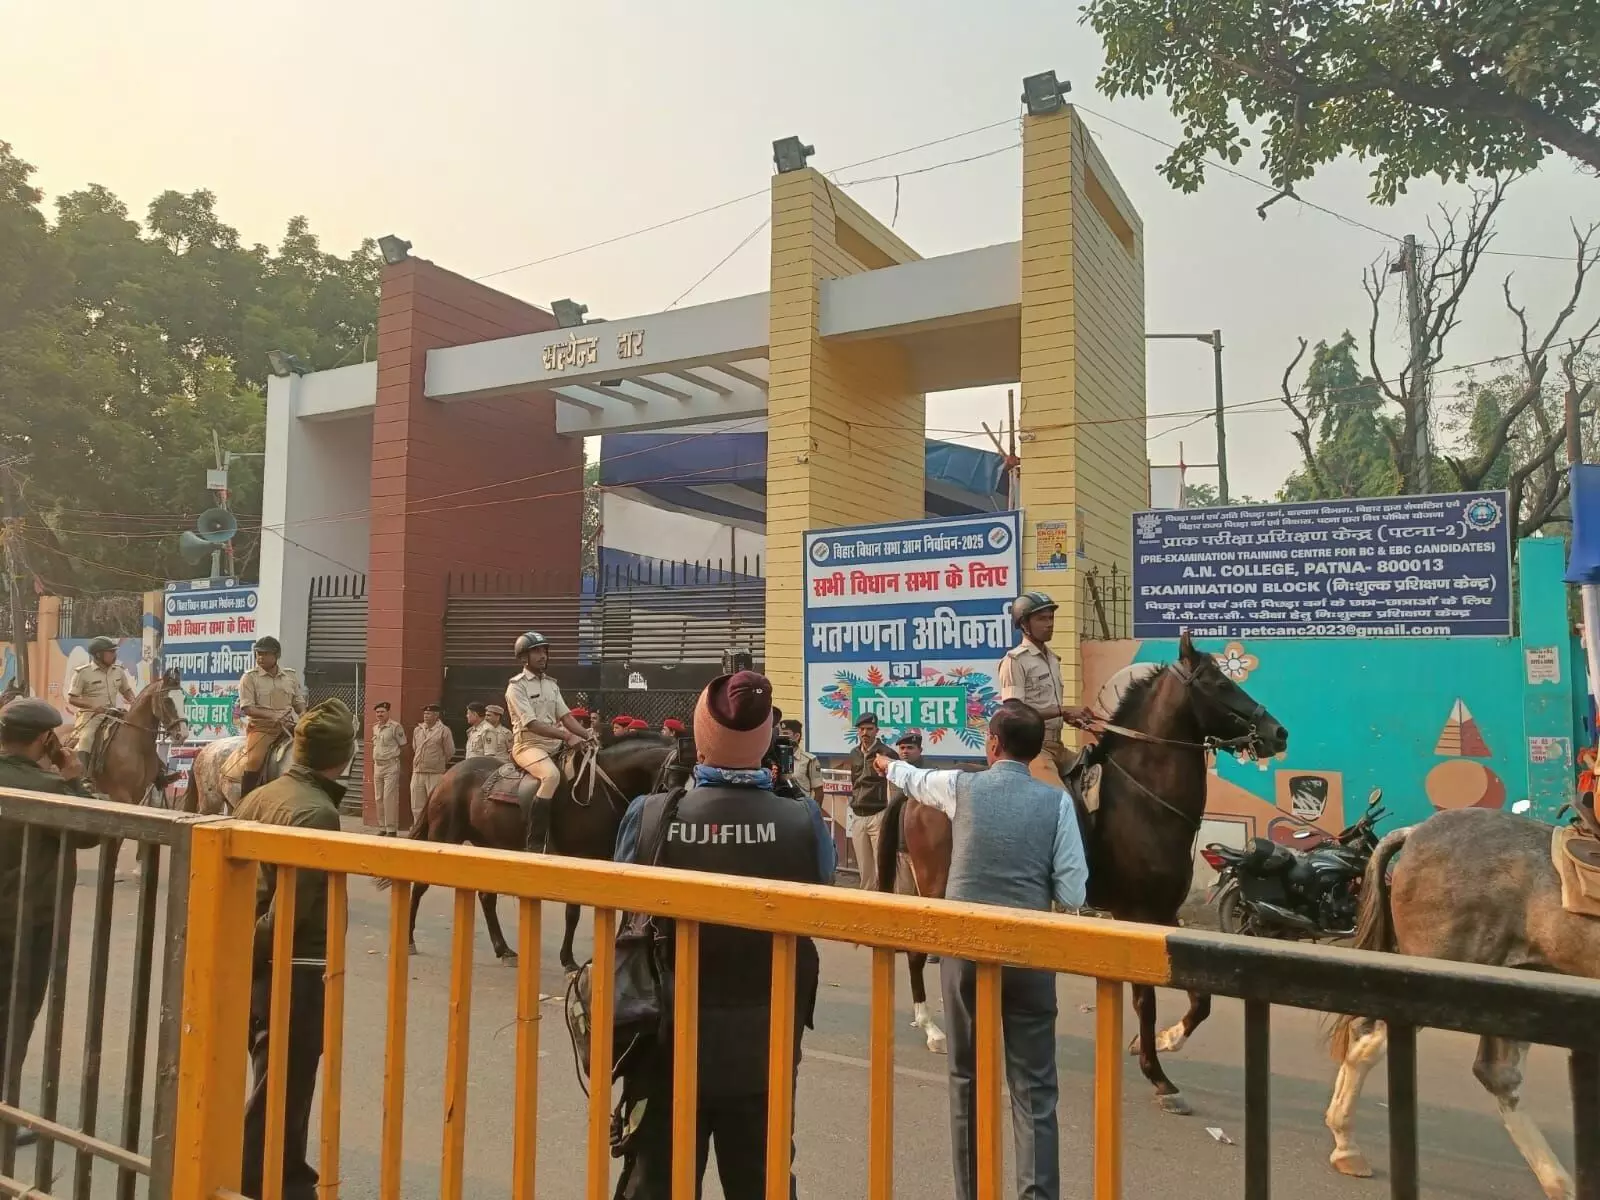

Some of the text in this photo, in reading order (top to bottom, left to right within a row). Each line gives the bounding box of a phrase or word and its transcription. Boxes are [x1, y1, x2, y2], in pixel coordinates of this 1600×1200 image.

[1206, 512, 1220, 520] एवं
[1220, 511, 1238, 520] अति
[833, 532, 984, 560] बिहार विधान सभा आम निर्वाचन-2025
[1202, 531, 1254, 546] परीक्षा
[1255, 528, 1329, 545] प्रशिक्षण
[1331, 526, 1373, 541] केन्द्र
[1141, 542, 1496, 564] (PRE-EXAMINATION TRAINING CENTRE FOR BC & EBC CANDIDATES)
[1182, 558, 1444, 578] A.N. COLLEGE, PATNA- 800013
[813, 562, 1009, 597] सभी विधान सभा के लिए
[1141, 583, 1257, 596] EXAMINATION
[1262, 581, 1321, 594] BLOCK
[1394, 575, 1450, 592] प्रशिक्षण
[1145, 600, 1180, 611] पिछड़ा
[1184, 600, 1206, 609] वर्ग
[1208, 600, 1229, 609] एवं
[1230, 599, 1257, 609] अति
[1261, 599, 1299, 610] पिछड़ा
[1303, 598, 1327, 607] वर्ग
[1330, 597, 1345, 606] के
[1441, 596, 1457, 605] के
[1462, 595, 1493, 605] लिए
[1248, 610, 1286, 619] परीक्षा
[1290, 609, 1312, 622] हेतु
[1376, 608, 1431, 618] प्रशिक्षण
[1435, 607, 1471, 618] केन्द्र
[167, 616, 255, 636] सभी विधान सभा के लिए
[811, 618, 907, 653] मतगणना
[1179, 625, 1227, 636] E-mail
[1241, 624, 1451, 639] petcanc2023@gmail.com
[892, 661, 920, 677] का
[200, 681, 213, 692] का
[211, 704, 230, 722] द्वार
[919, 697, 959, 725] द्वार
[667, 822, 776, 844] FUJIFILM
